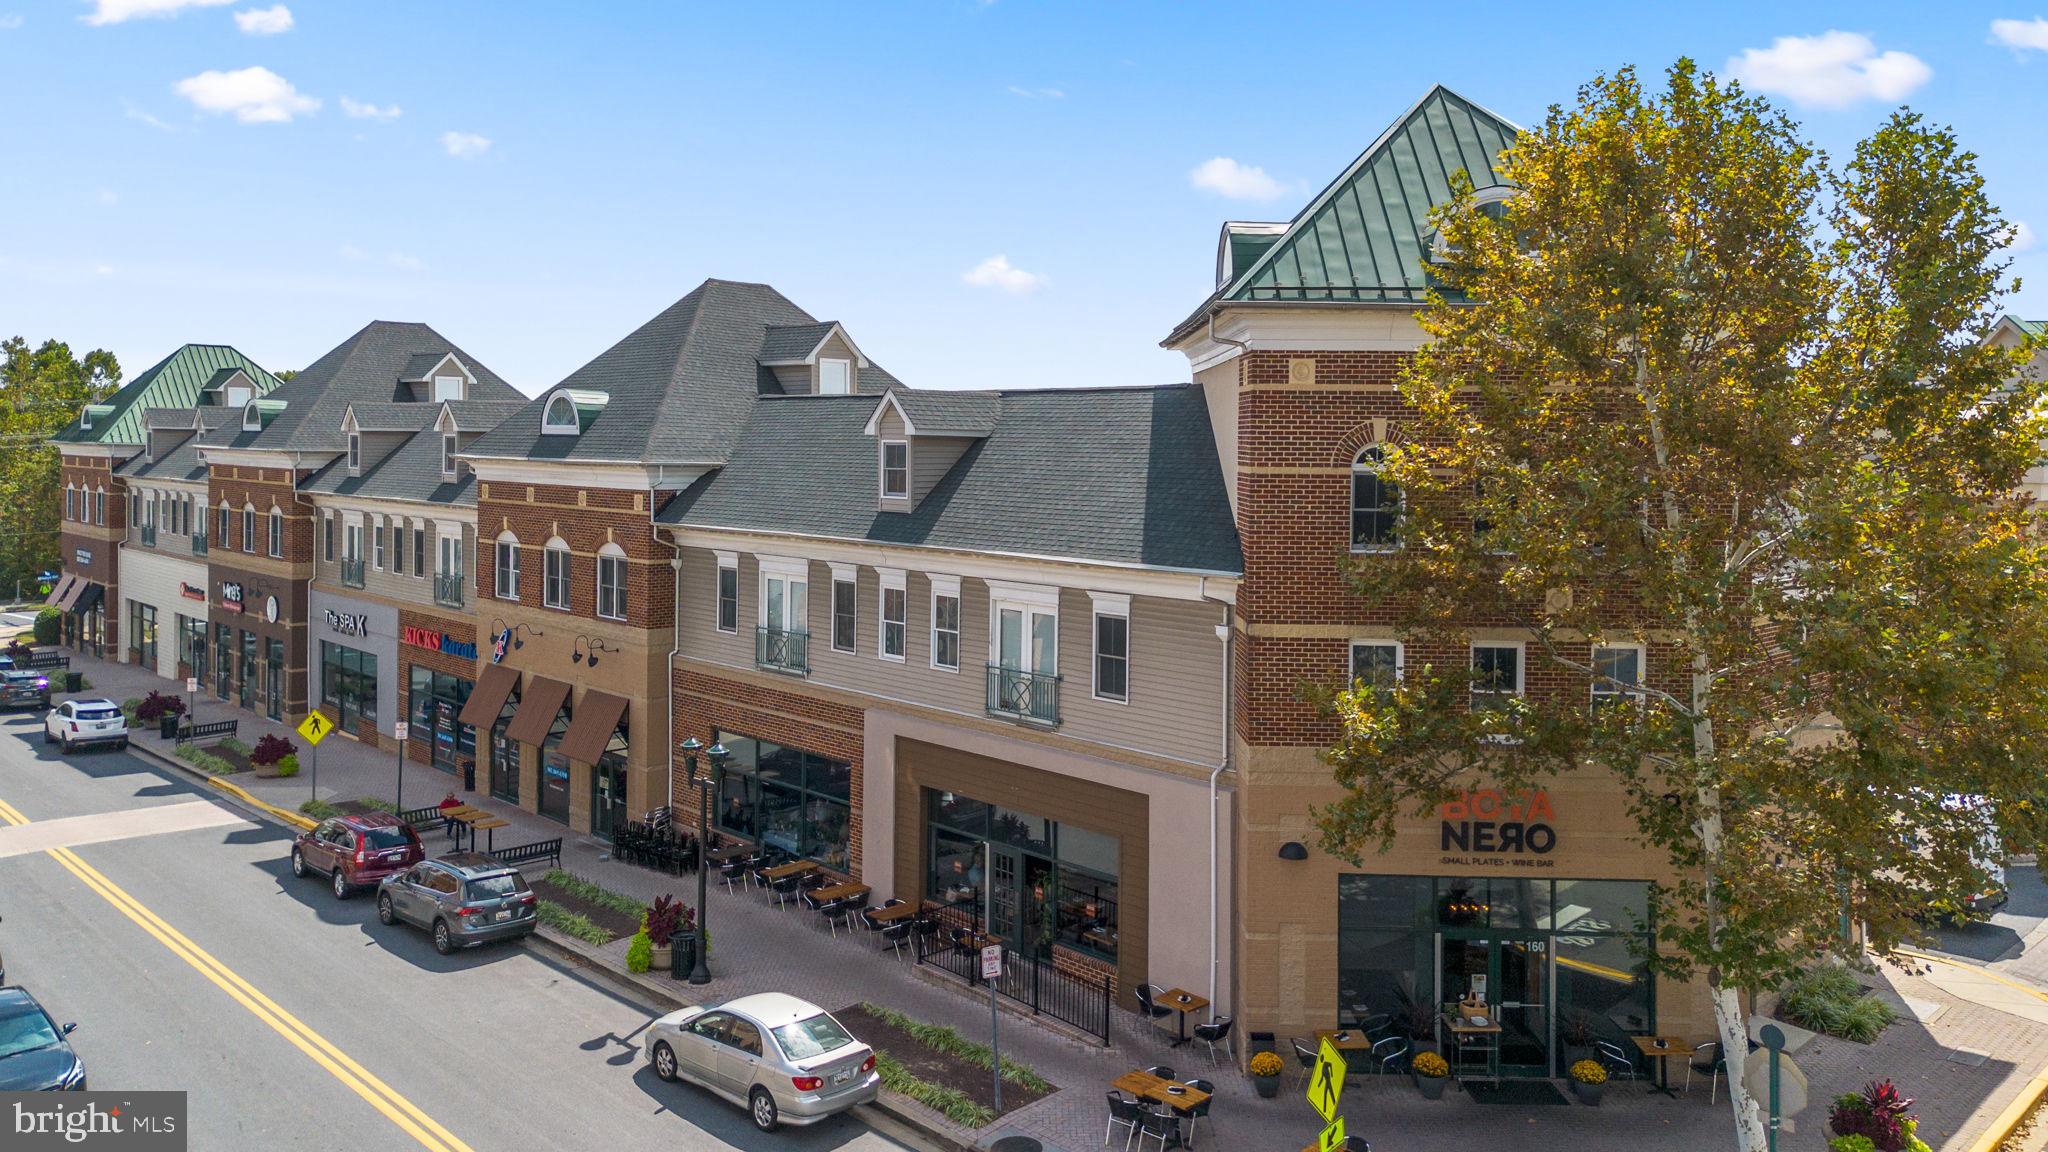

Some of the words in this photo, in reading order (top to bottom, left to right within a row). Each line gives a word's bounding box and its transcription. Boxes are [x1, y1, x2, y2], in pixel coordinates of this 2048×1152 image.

[324, 609, 338, 626] The
[339, 613, 355, 630] SPA
[356, 614, 367, 638] K
[404, 626, 439, 651] KICKS
[1441, 821, 1556, 854] NERO
[1441, 857, 1471, 866] SMALL
[1472, 857, 1505, 866] PLATES
[1511, 859, 1534, 867] WINE
[1526, 941, 1545, 952] 160
